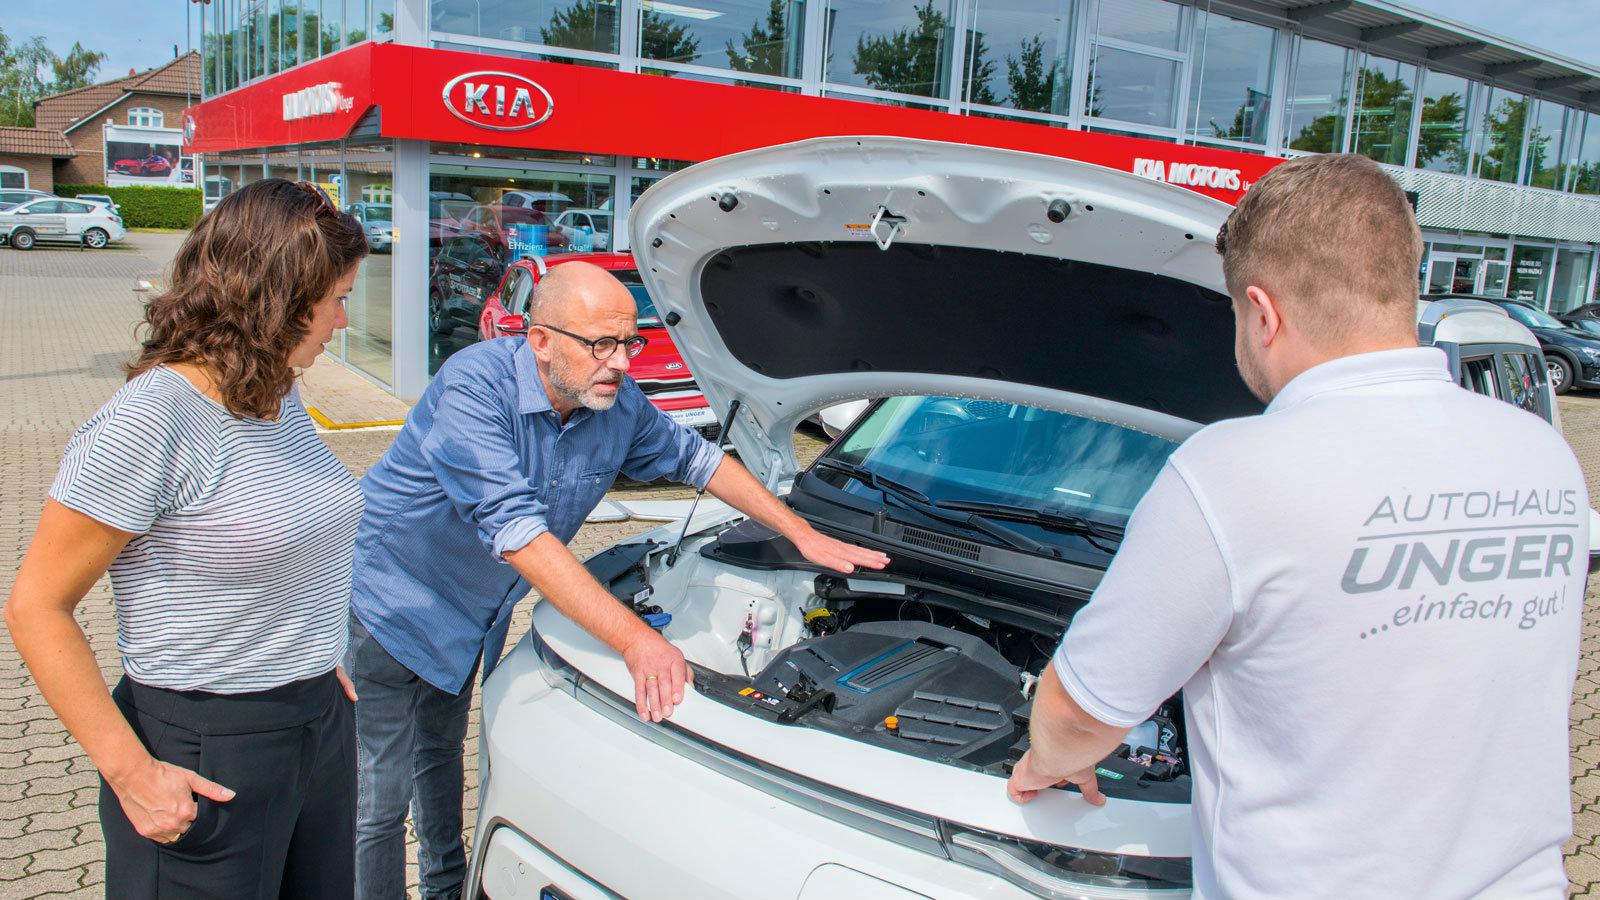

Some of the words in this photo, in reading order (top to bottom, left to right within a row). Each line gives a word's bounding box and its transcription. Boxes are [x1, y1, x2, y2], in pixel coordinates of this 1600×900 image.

[464, 82, 536, 119] KIA
[1133, 158, 1166, 181] KIA
[1168, 163, 1240, 191] MOTORS
[1363, 489, 1576, 527] AUTOHAUS
[1341, 534, 1574, 594] UNGER
[1518, 584, 1566, 630] gut!
